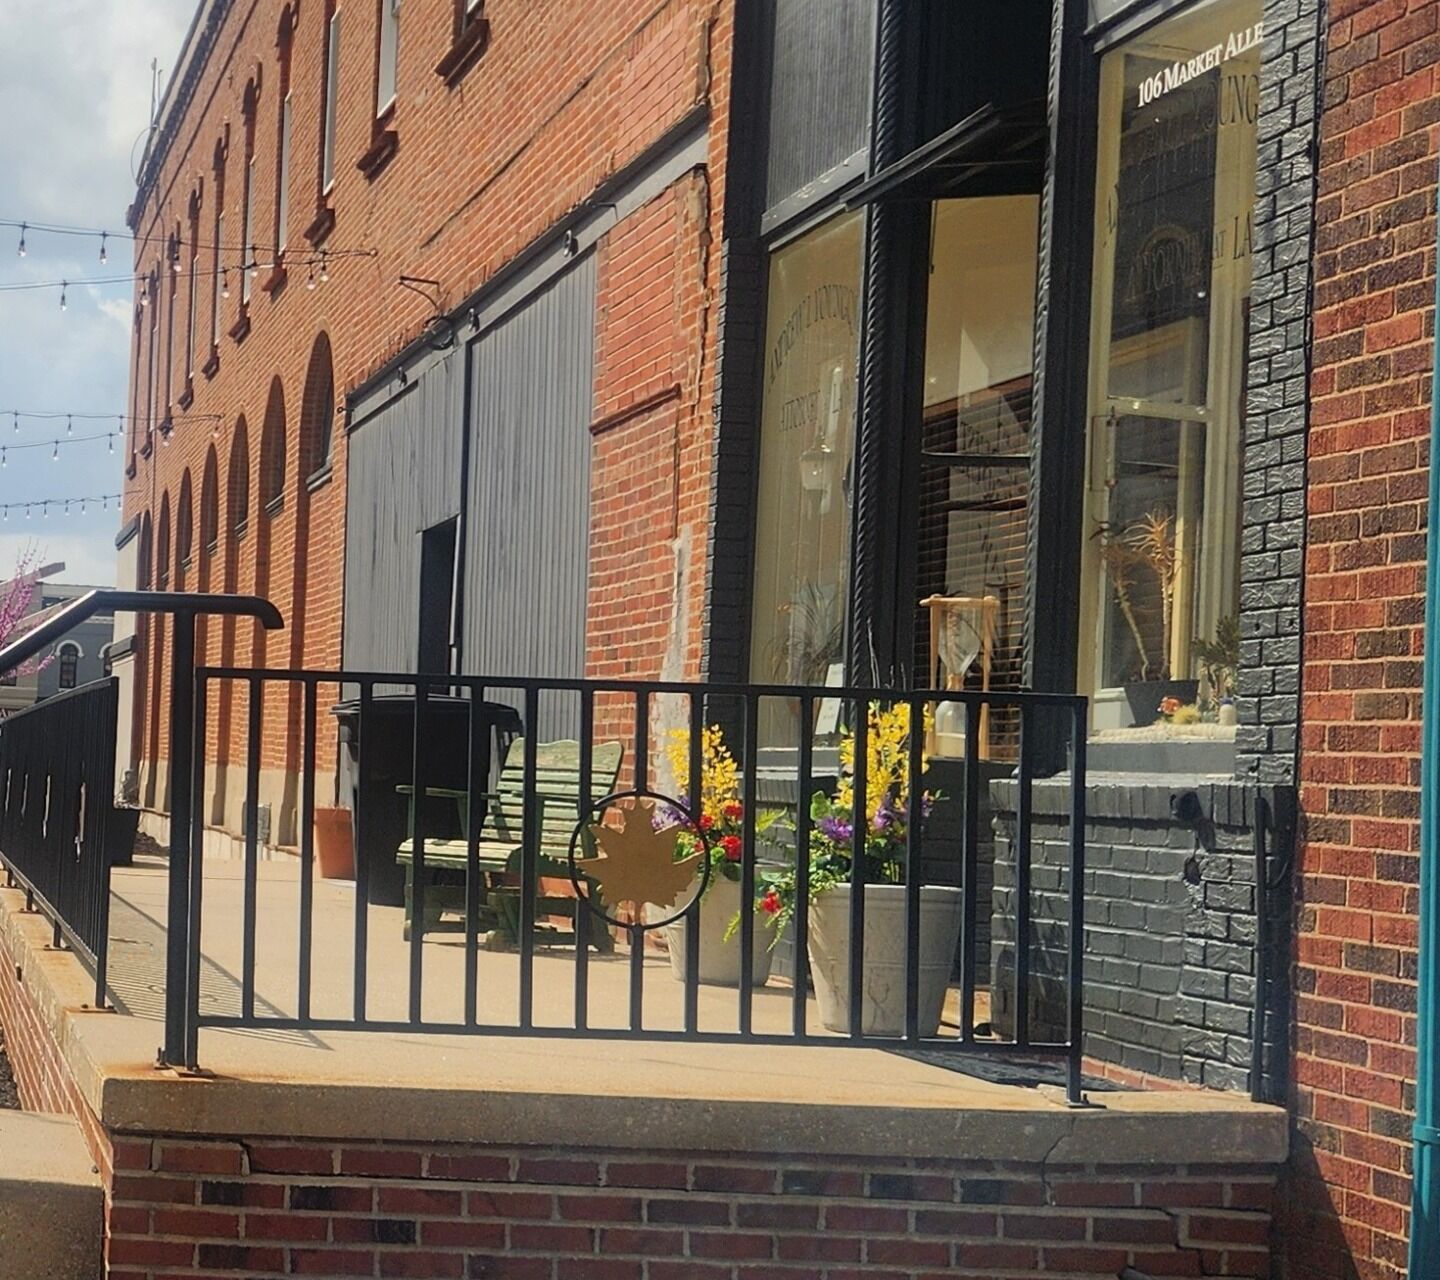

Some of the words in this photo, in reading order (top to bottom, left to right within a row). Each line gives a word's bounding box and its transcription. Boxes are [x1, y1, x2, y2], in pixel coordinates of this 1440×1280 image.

[1137, 71, 1163, 108] 106
[1162, 43, 1223, 94] MARKET
[1223, 22, 1264, 61] ALLE
[1233, 210, 1253, 259] LA
